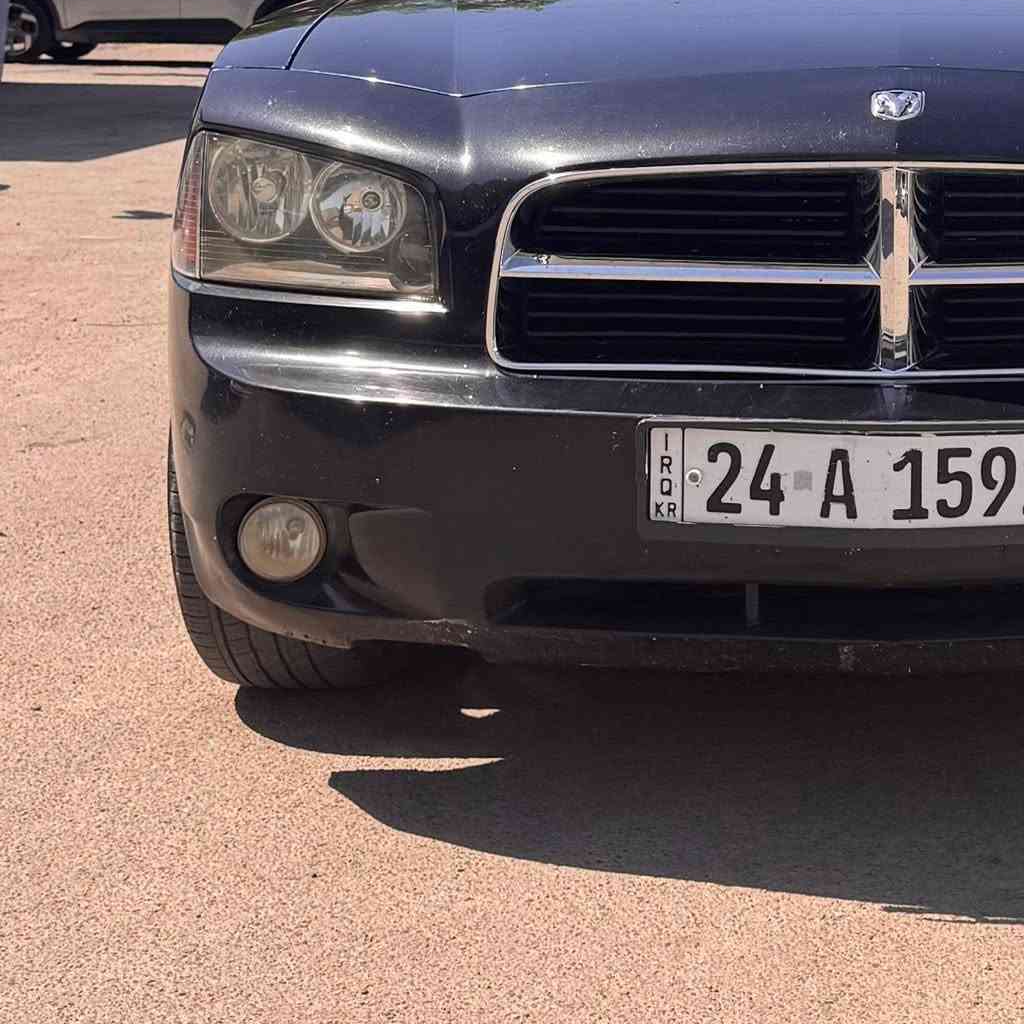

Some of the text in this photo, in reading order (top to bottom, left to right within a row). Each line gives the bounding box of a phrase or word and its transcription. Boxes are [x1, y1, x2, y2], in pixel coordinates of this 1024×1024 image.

[660, 433, 672, 496] IRQ
[706, 442, 784, 516] 24
[820, 449, 857, 519] A
[655, 502, 676, 517] KR
